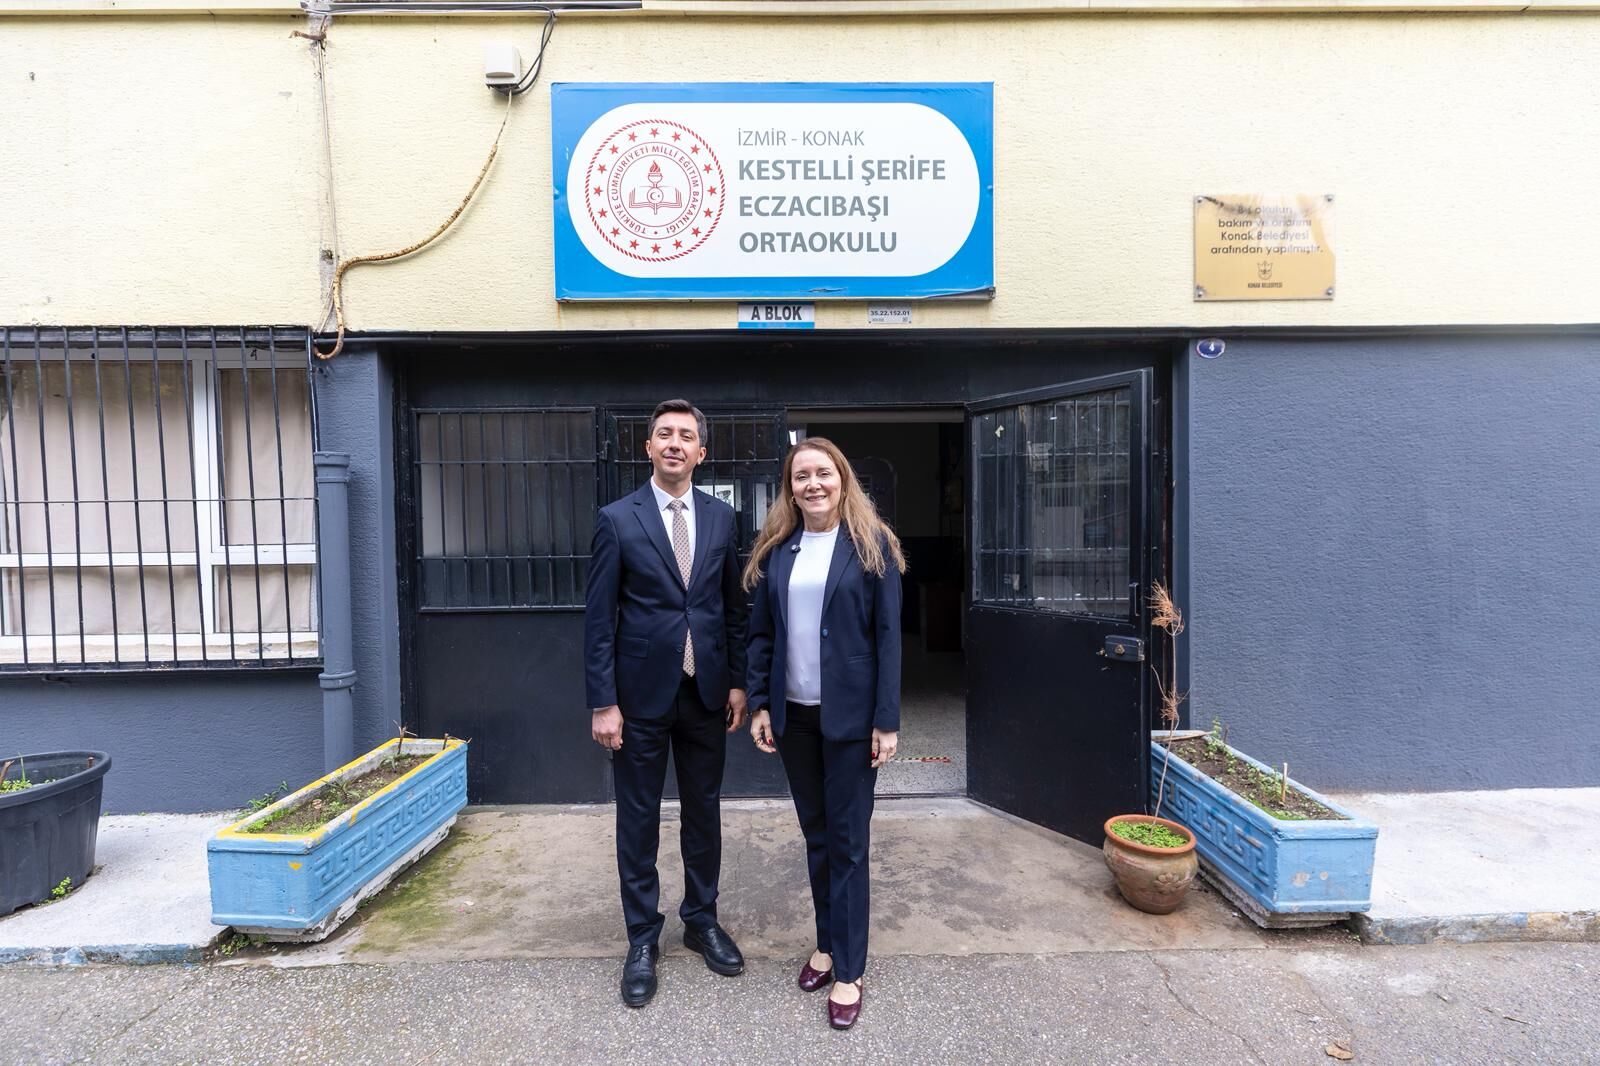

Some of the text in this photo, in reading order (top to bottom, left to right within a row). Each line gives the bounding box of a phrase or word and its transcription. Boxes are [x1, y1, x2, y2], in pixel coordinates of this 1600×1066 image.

[738, 128, 787, 146] İZMİR
[802, 130, 865, 146] KONAK
[739, 154, 946, 186] KESTELLİ ŞERİFE
[611, 145, 700, 234] TÜRKİYE CUMHURİYETİ MİLLİ EĞİTİM BAKANLIĞI
[739, 196, 889, 222] ECZACIBAŞI
[1218, 219, 1253, 228] bakım
[739, 231, 897, 253] ORTAOKULU
[1221, 231, 1309, 243] Konak Belediyesi
[751, 305, 802, 321] A BLOK
[1209, 341, 1215, 351] 4
